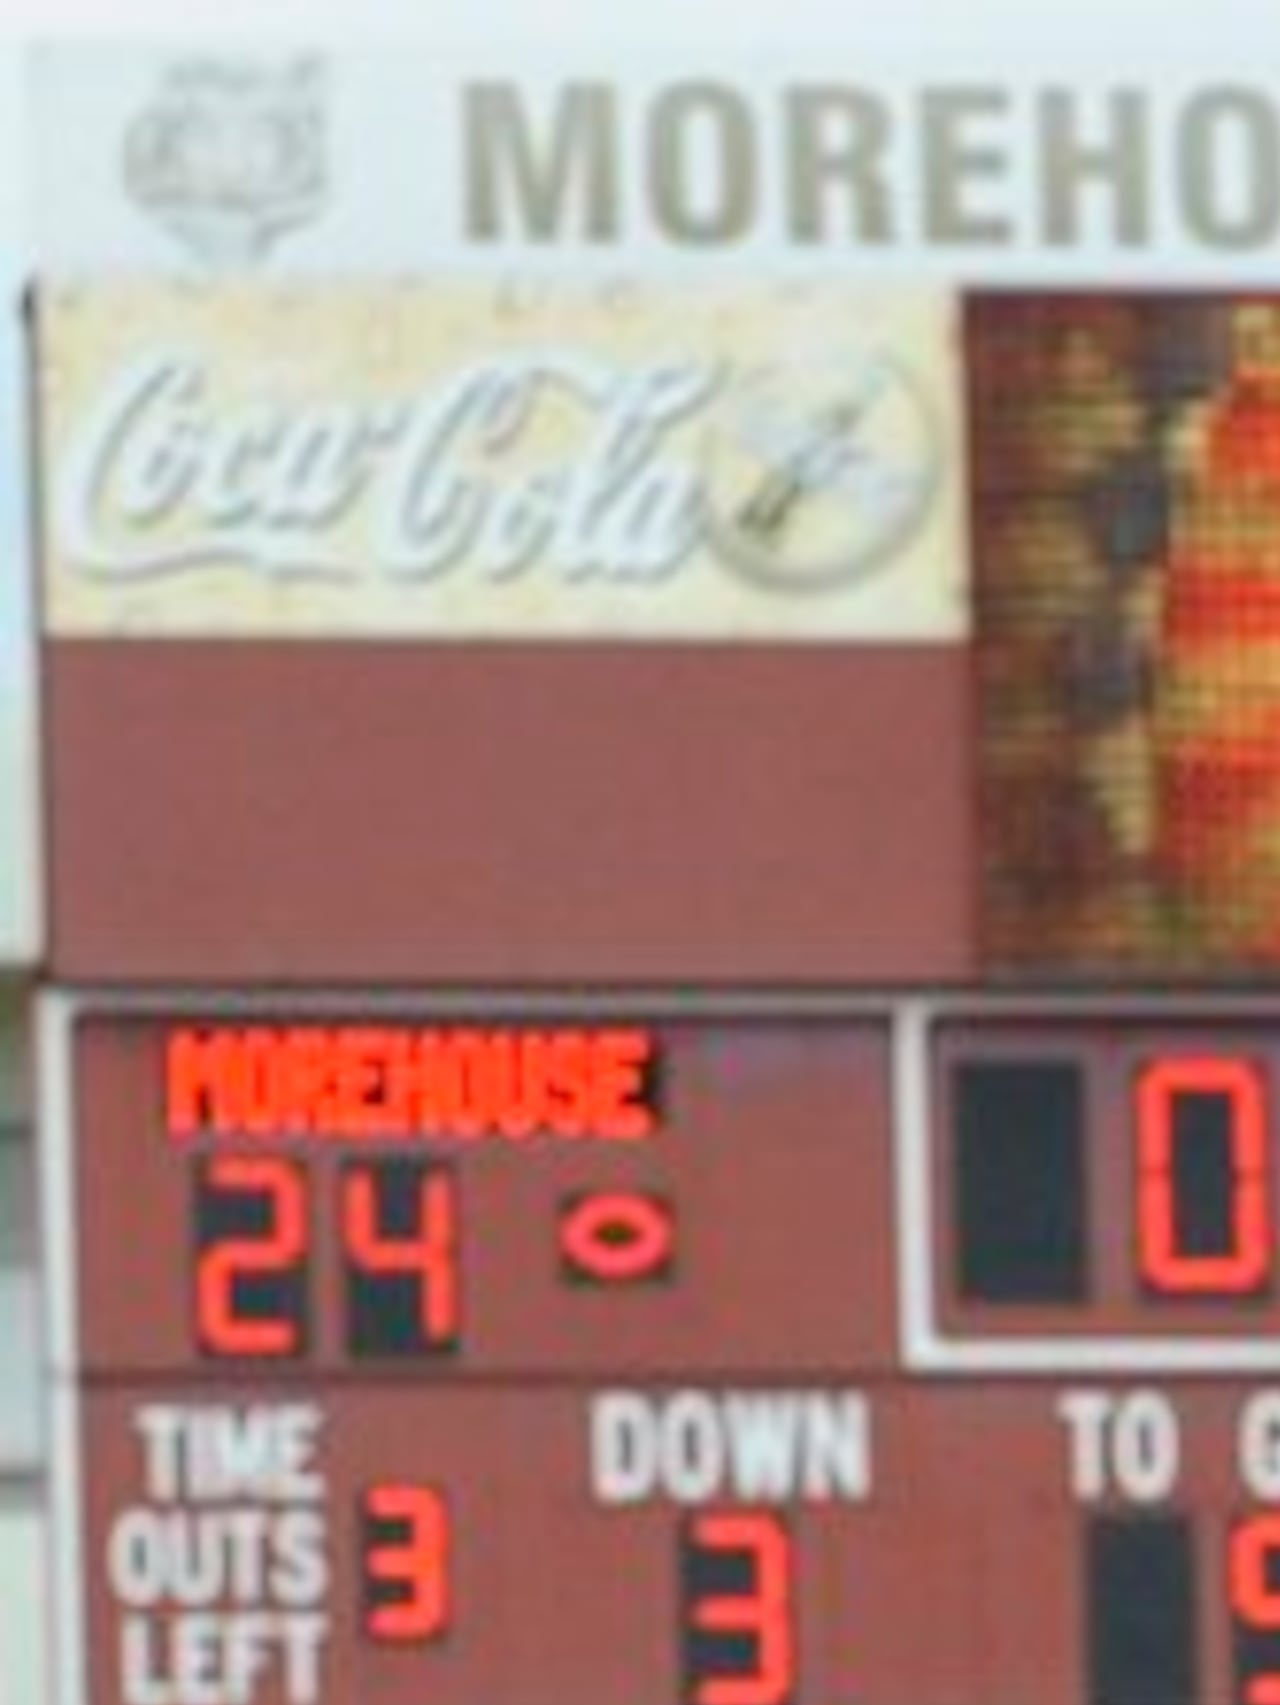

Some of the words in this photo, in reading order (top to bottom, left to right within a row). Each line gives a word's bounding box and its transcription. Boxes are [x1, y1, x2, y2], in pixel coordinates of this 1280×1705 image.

[62, 356, 722, 586] Coca-Cola
[164, 1026, 658, 1140] MOREHOUSE
[198, 1154, 456, 1356] 24
[135, 1402, 328, 1502] TIME
[590, 1390, 872, 1502] DOWN
[1058, 1388, 1180, 1502] TO
[106, 1506, 330, 1606] OUTS
[364, 1484, 450, 1642] 3
